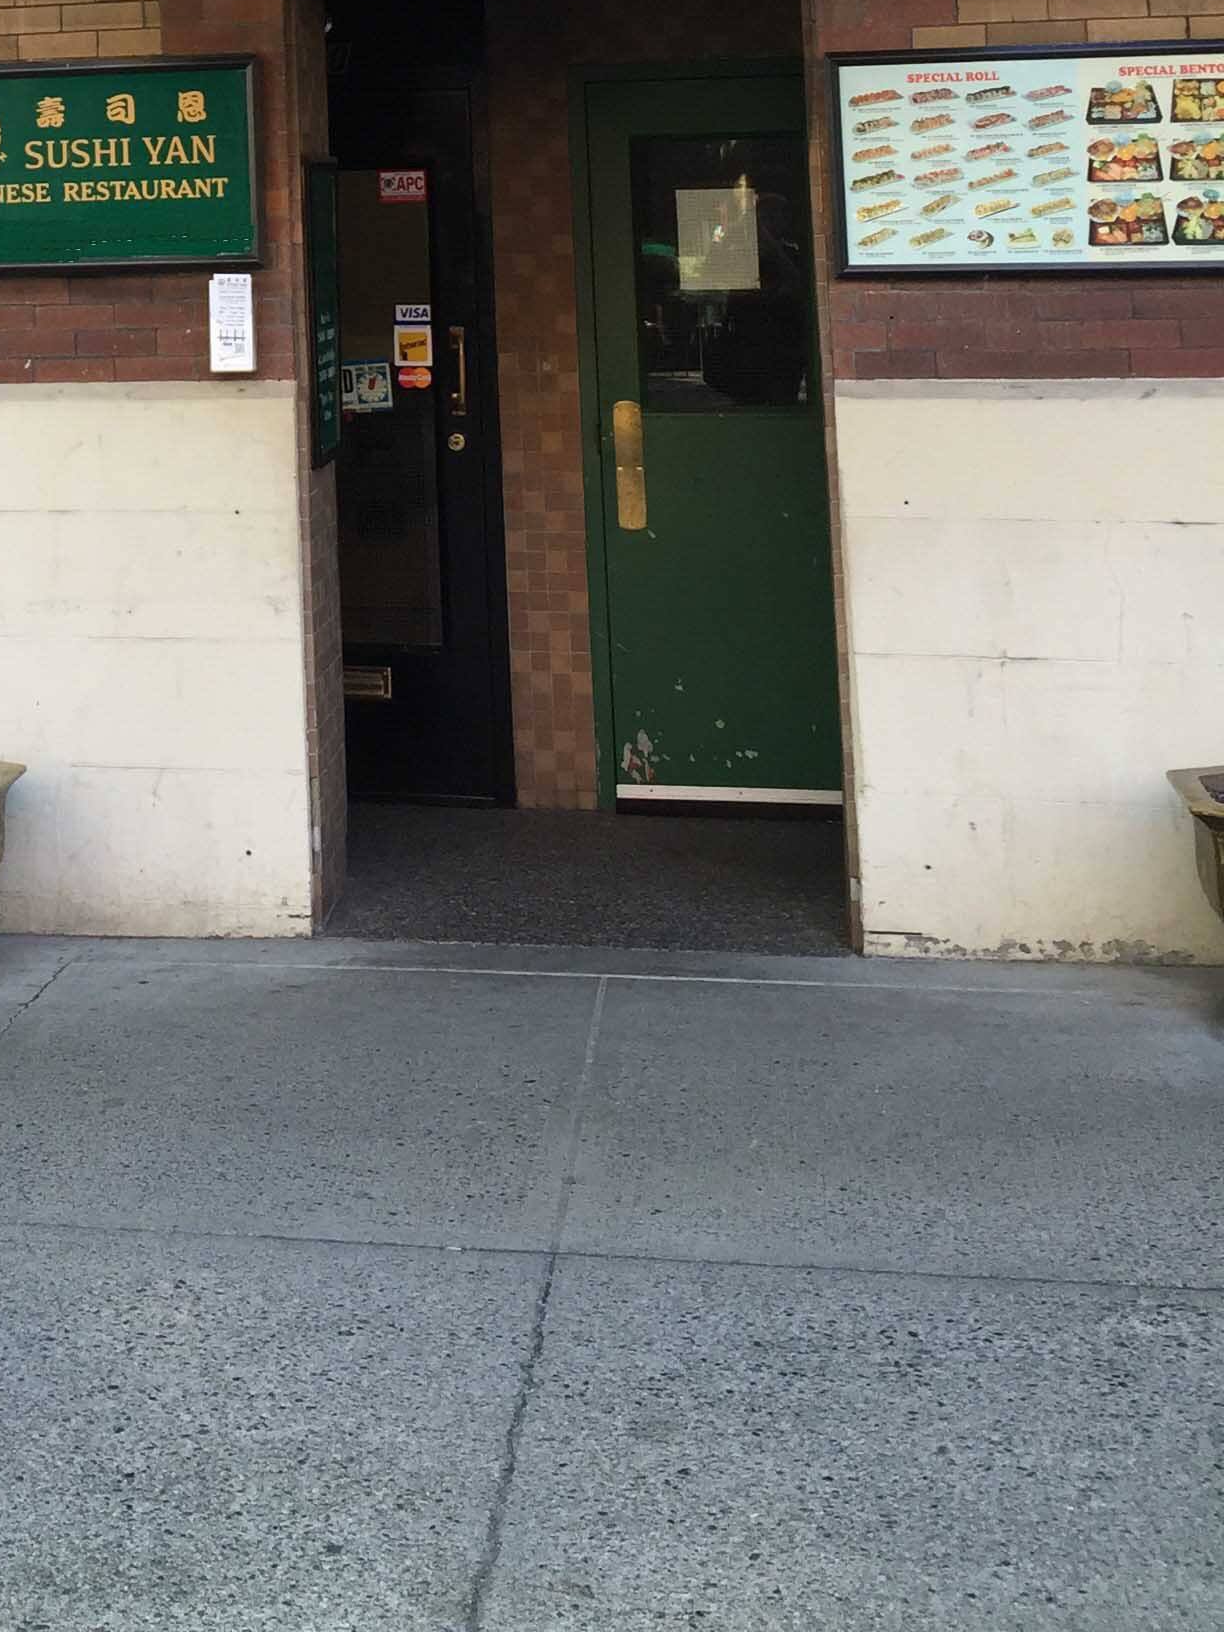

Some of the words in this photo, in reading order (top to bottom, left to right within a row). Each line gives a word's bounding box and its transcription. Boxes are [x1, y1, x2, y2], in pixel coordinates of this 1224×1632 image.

[906, 71, 963, 83] SPECIAL
[966, 70, 1000, 82] ROLL
[1119, 65, 1176, 77] SPECIAL
[25, 137, 130, 169] SUSHI
[142, 135, 216, 166] YAN
[64, 177, 228, 202] RESTAURANT
[400, 307, 429, 319] VISA
